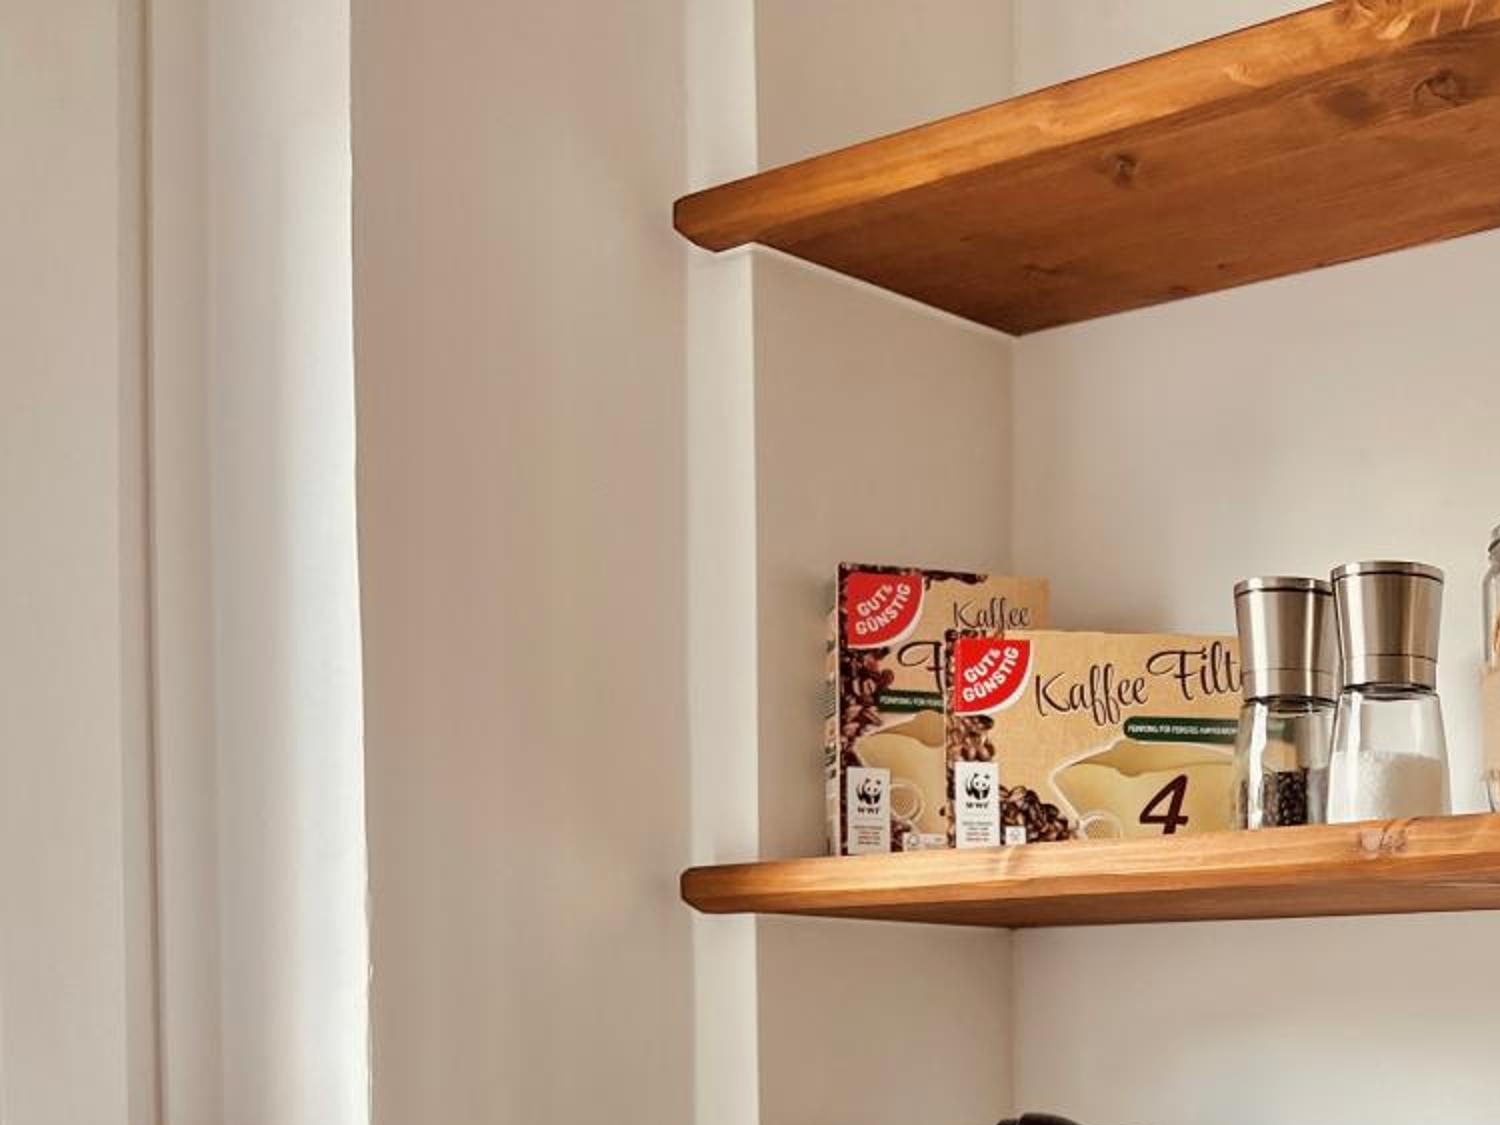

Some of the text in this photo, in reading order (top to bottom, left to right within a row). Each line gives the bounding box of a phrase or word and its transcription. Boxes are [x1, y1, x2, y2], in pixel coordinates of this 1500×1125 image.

[855, 583, 911, 635] GÜNSTIG
[953, 597, 1031, 631] Kaffee
[963, 646, 1019, 702] GÜNSTIG
[1035, 641, 1244, 726] Kaffee Filt
[1139, 774, 1189, 834] 4
